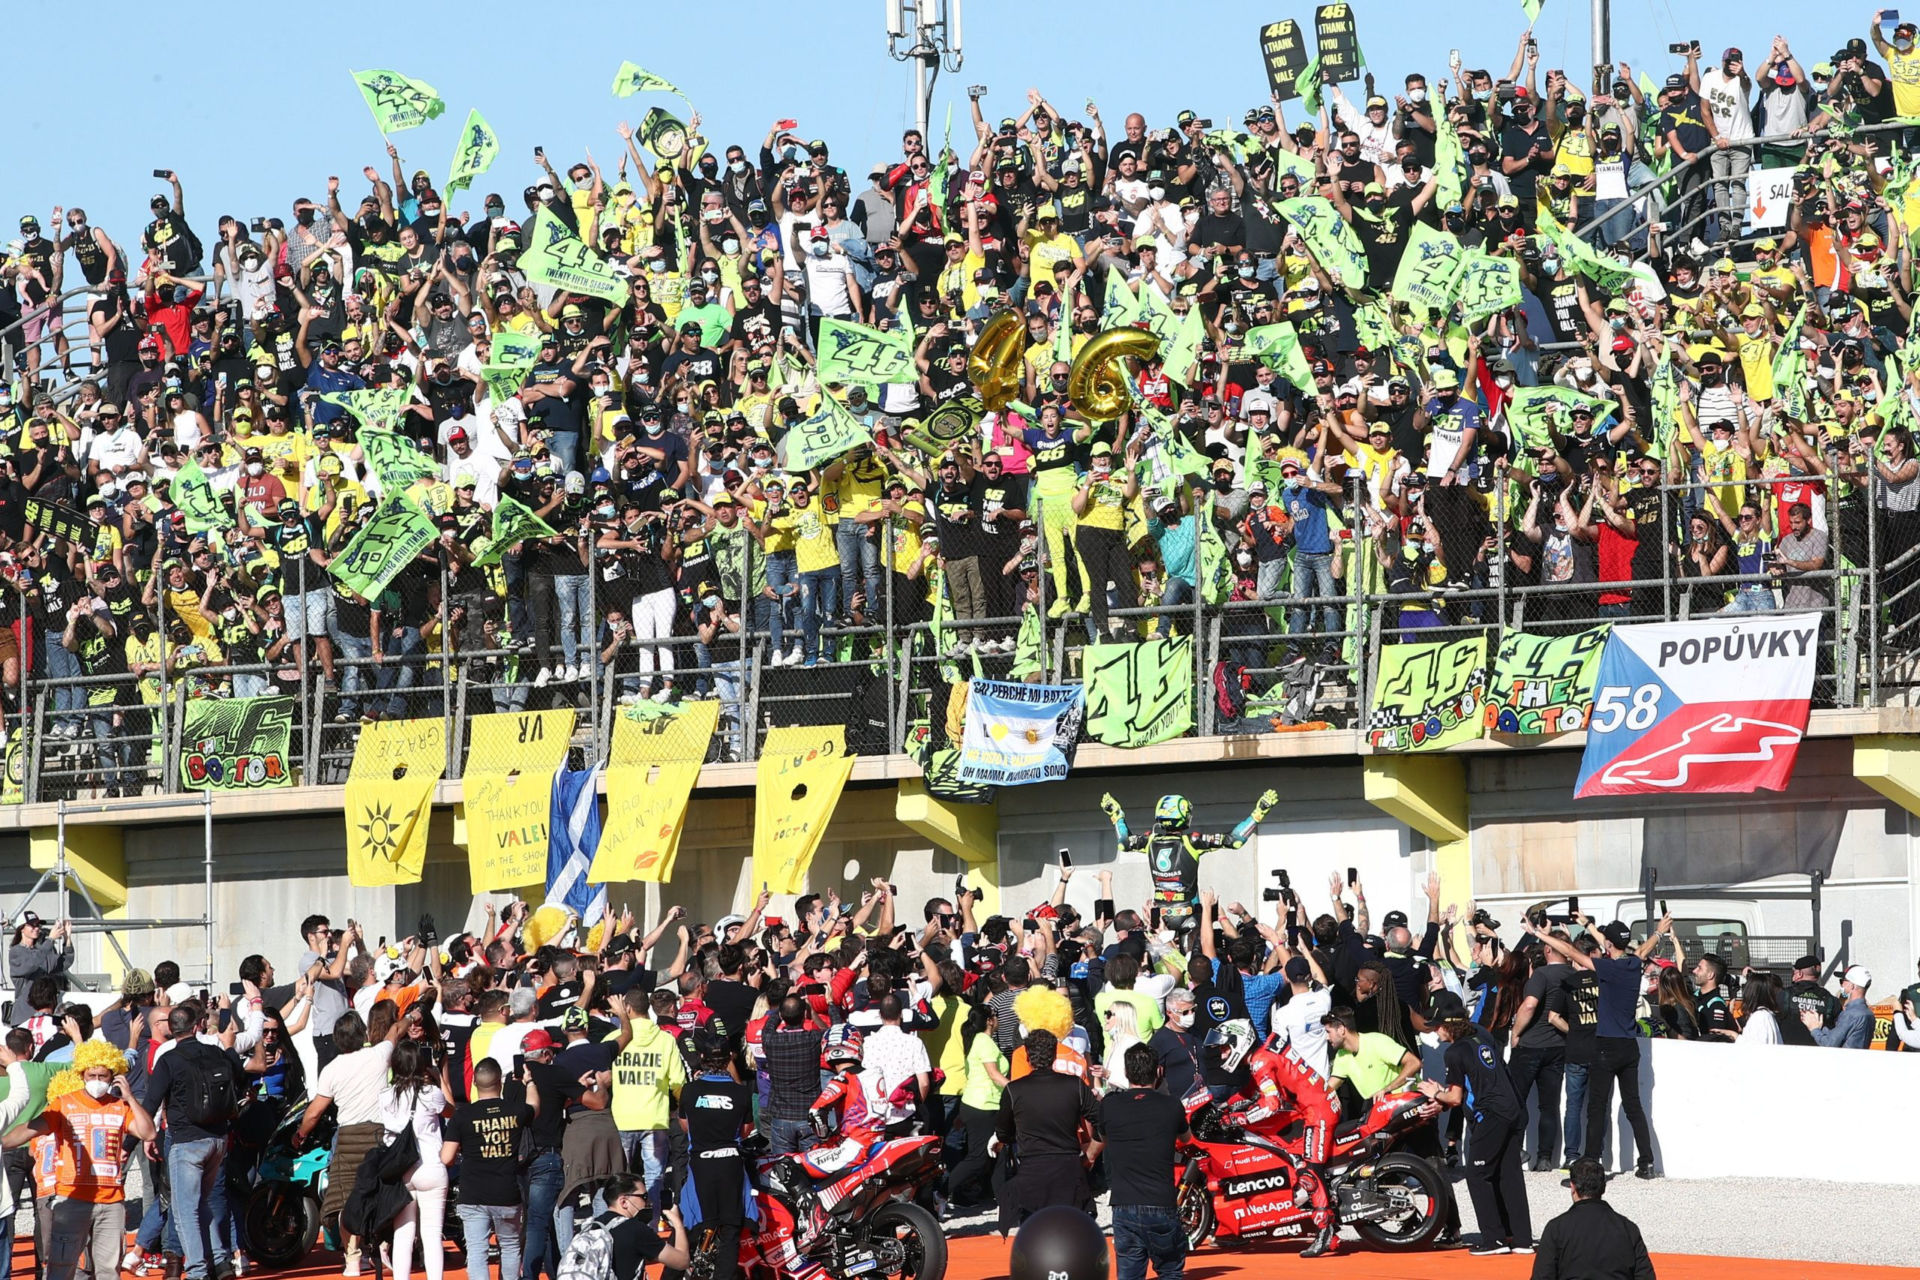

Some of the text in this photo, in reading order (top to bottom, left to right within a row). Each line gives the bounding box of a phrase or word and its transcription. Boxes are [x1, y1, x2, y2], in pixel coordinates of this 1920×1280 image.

[1321, 4, 1346, 19] 46
[1265, 20, 1292, 38] 46
[1321, 21, 1346, 33] THANK
[1268, 37, 1294, 53] THANK
[1323, 38, 1338, 50] YOU
[1271, 55, 1287, 69] YOU
[1324, 53, 1343, 66] VALE
[1274, 69, 1295, 84] VALE
[1375, 233, 1397, 244] 46
[545, 267, 587, 287] TWENTY-FIFTH
[590, 278, 614, 292] SEASON
[1551, 284, 1575, 296] 46
[1556, 308, 1569, 320] YOU
[279, 359, 297, 371] VALE
[832, 338, 909, 376] 46
[1037, 444, 1066, 462] 46
[26, 500, 39, 524] 46
[40, 508, 54, 530] THANK
[56, 521, 68, 536] YOU
[69, 524, 83, 544] VALE
[281, 533, 308, 555] 46
[1738, 544, 1756, 557] 46
[1658, 624, 1815, 668] POPŮVKY
[1382, 642, 1479, 718] 46
[973, 681, 989, 696] SAI
[1028, 688, 1041, 703] MI
[1505, 678, 1573, 709] THE
[1592, 683, 1662, 733] 58
[1371, 686, 1484, 749] THE DOCTOR
[182, 697, 294, 757] 46
[195, 736, 226, 755] THE
[187, 754, 284, 787] DOCTOR
[962, 766, 974, 778] OH
[1044, 764, 1067, 778] SONO
[485, 800, 544, 822] THANK YOU
[497, 823, 547, 849] VALE!
[499, 855, 514, 865] THE
[1152, 869, 1182, 878] PETRONAS
[1211, 1001, 1225, 1012] sky
[1792, 995, 1825, 1007] GUARDIA
[1798, 1002, 1817, 1011] CIVIL
[613, 1051, 663, 1068] GRAZIE
[618, 1069, 656, 1086] VALE!
[472, 1115, 518, 1133] THANK
[482, 1131, 511, 1144] YOU
[1304, 1127, 1314, 1159] Lenovo
[1336, 1133, 1360, 1145] Lenovo
[479, 1143, 512, 1159] VALE
[1235, 1153, 1273, 1165] Audi Sport
[1228, 1175, 1285, 1196] Lenovo
[1247, 1199, 1293, 1217] NetApp
[739, 1227, 790, 1248] PRAMAC
[1272, 1223, 1302, 1237] GIVI
